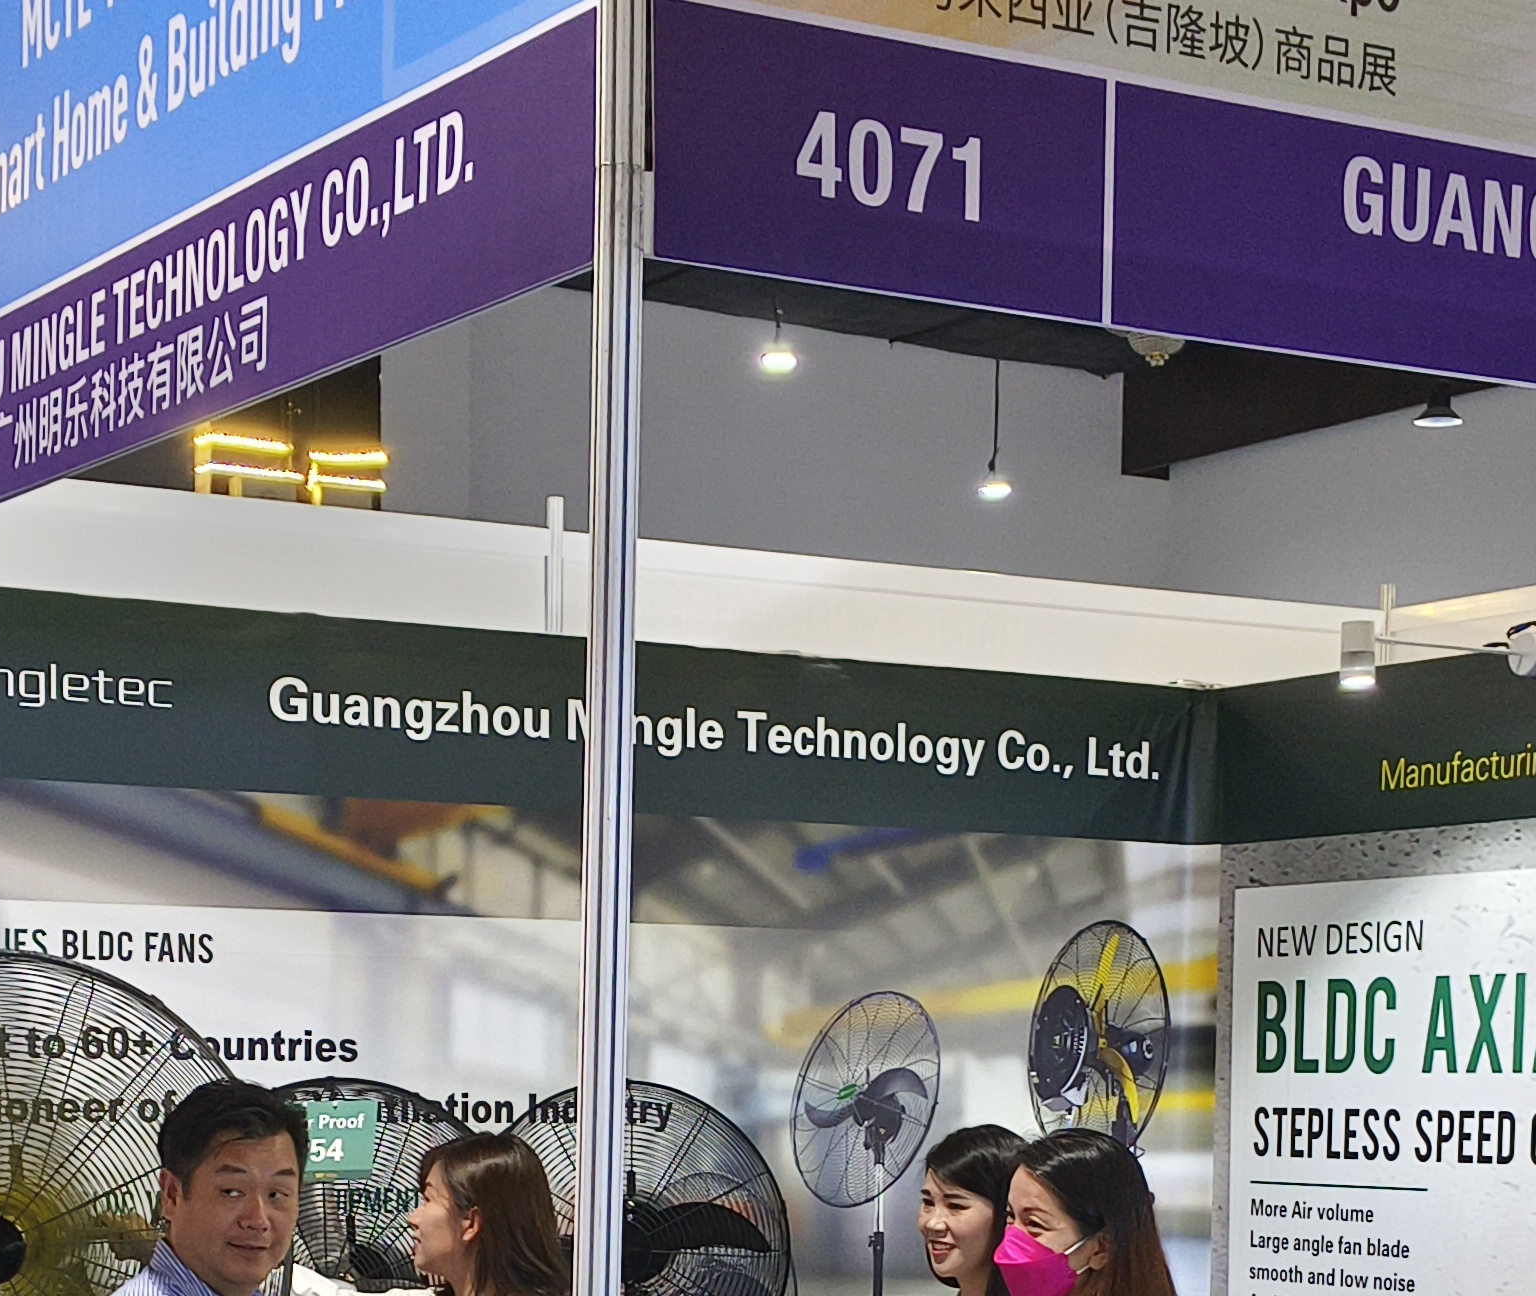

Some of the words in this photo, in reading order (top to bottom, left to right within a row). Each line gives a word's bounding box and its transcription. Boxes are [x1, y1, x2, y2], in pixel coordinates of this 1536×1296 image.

[934, 0, 1397, 96] 西亚(吉隆坡)商品展
[52, 71, 128, 183] Home
[136, 34, 158, 130] &
[796, 110, 982, 223] 4071
[11, 289, 105, 394] MINGLE
[113, 181, 312, 341] TECHNOLOGY
[321, 110, 474, 247] CO.,LTD.
[268, 675, 552, 742] Guangzhou
[568, 698, 724, 757] Mngle
[738, 710, 985, 777] Technology
[997, 729, 1075, 779] Co.,
[1087, 736, 1161, 780] Ltd.
[63, 929, 134, 962] BLDC
[145, 932, 214, 964] FANS
[1257, 924, 1318, 958] NEW
[1325, 919, 1425, 955] DESIGN
[26, 1027, 65, 1059] to
[82, 1026, 154, 1060] 60+
[170, 1029, 359, 1063] Countries
[1257, 977, 1397, 1076] BLDC
[137, 1090, 175, 1124] of
[529, 1092, 673, 1132] Indtry
[318, 1112, 365, 1130] Proof
[309, 1138, 345, 1162] 54
[1254, 1107, 1401, 1164] STEPLESS
[1415, 1110, 1516, 1166] SPEED
[1250, 1198, 1288, 1220] More
[1291, 1200, 1314, 1220] Air
[1317, 1202, 1374, 1224] volume
[1250, 1231, 1289, 1257] Large
[1292, 1234, 1334, 1258] angle
[1337, 1236, 1363, 1256] fan
[1367, 1238, 1410, 1260] blade
[1249, 1264, 1304, 1286] smooth
[1307, 1266, 1336, 1287] and
[1340, 1268, 1369, 1289] low
[1372, 1271, 1416, 1294] noise
